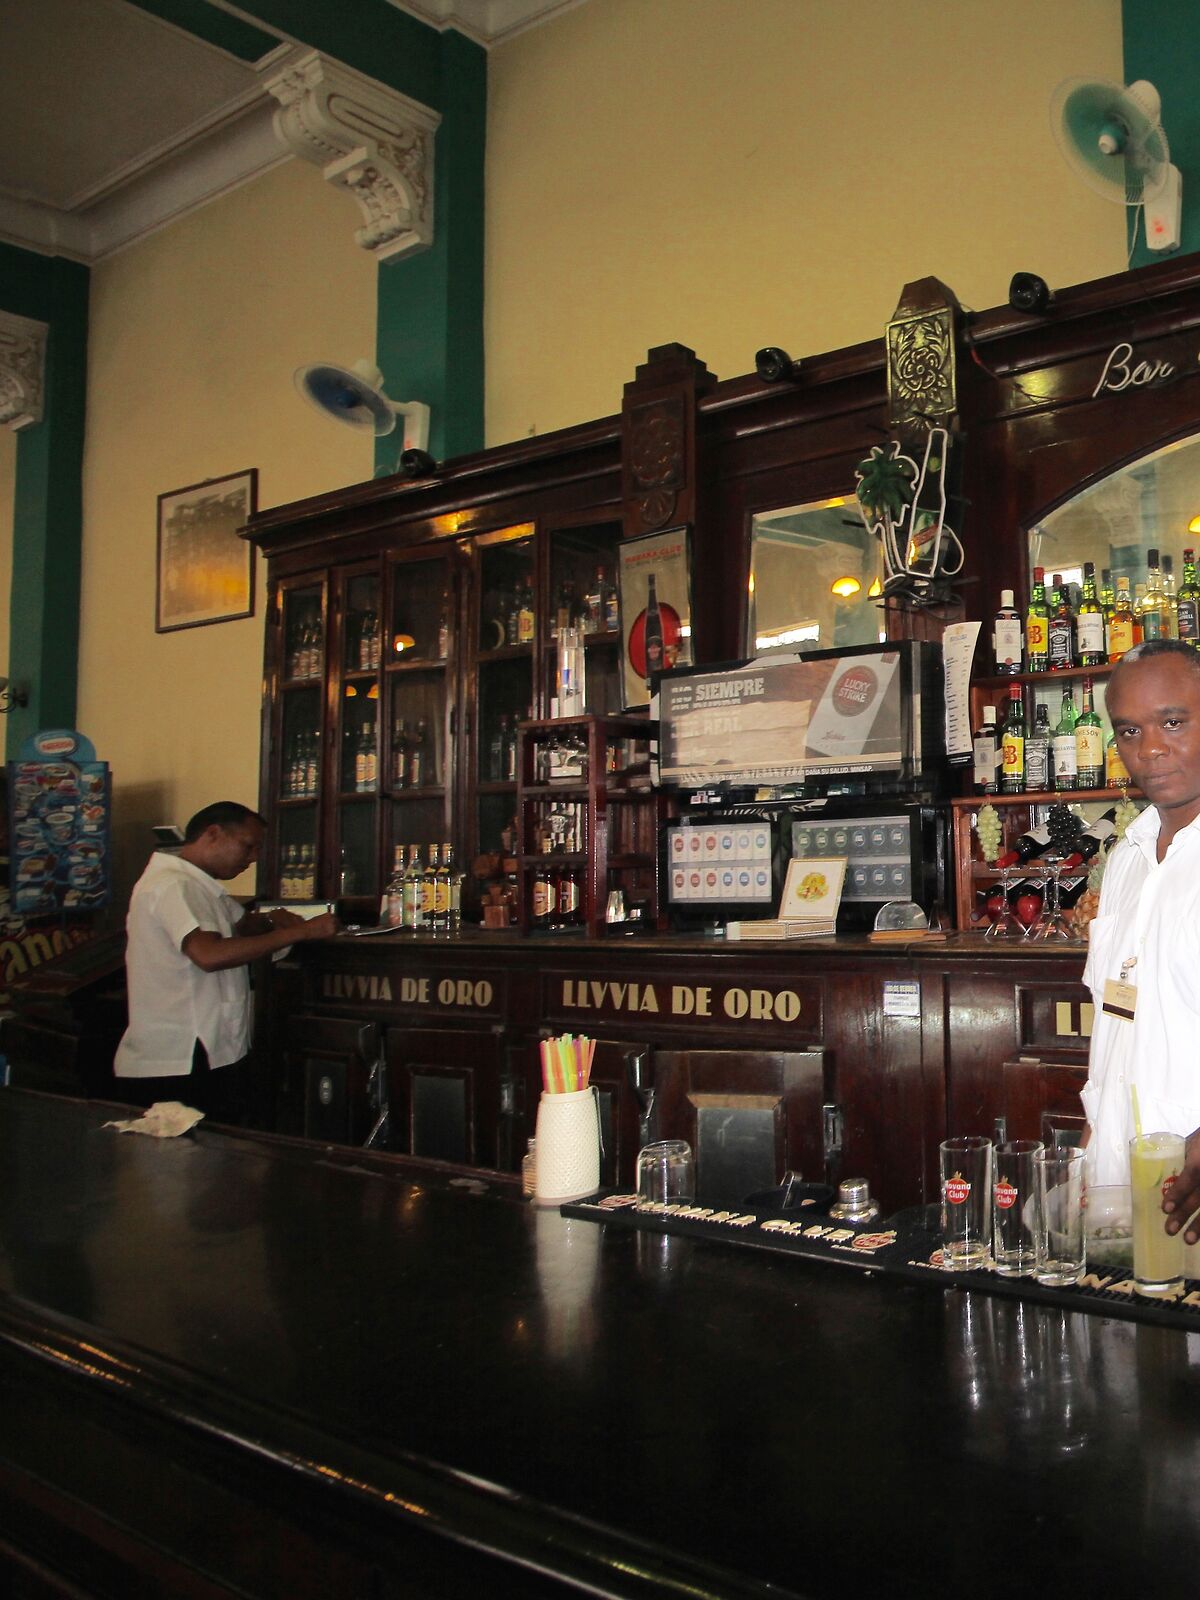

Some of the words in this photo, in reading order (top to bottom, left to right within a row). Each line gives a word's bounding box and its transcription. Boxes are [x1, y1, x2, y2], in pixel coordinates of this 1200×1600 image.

[1093, 343, 1174, 398] Bar
[695, 678, 764, 702] SIEMPRE
[839, 688, 867, 702] STRIKE
[844, 678, 871, 690] LUCKY
[402, 978, 430, 1003] DE
[438, 979, 493, 1007] ORO
[672, 985, 712, 1016] DE
[723, 988, 801, 1022] ORO
[949, 1190, 965, 1199] Club
